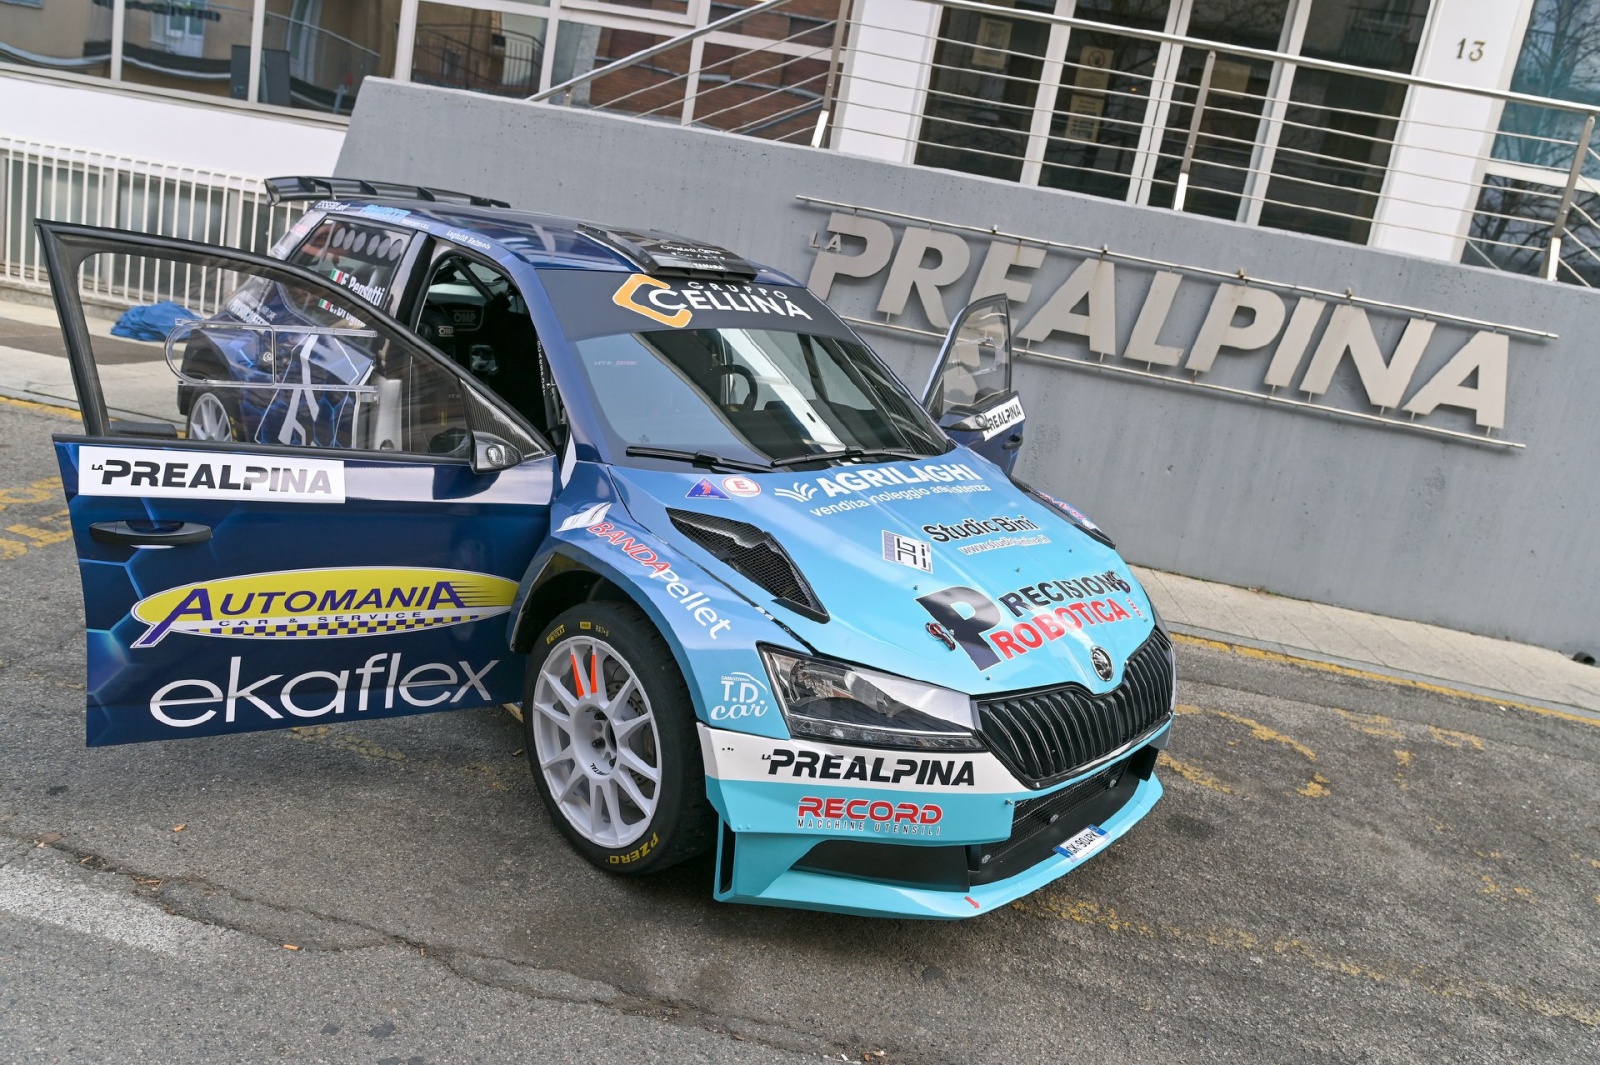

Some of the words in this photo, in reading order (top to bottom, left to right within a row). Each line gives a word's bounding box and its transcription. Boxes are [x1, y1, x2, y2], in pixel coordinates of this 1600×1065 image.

[1456, 38, 1486, 62] 13
[808, 230, 842, 252] LA
[348, 275, 386, 307] Pensotti
[648, 287, 814, 321] CELLINA
[687, 281, 788, 300] GRUPPO
[438, 327, 454, 335] OMP
[453, 312, 477, 324] OMP
[806, 211, 1509, 429] PREALPINA
[986, 403, 1022, 434] REALPINA
[91, 463, 104, 471] LA
[101, 459, 332, 494] PREALPINA
[816, 463, 983, 498] AGRILAGHI
[809, 498, 870, 517] vendita
[870, 487, 930, 504] noleggio
[930, 483, 992, 495] assistenza
[922, 519, 1000, 543] Studio
[991, 515, 1042, 533] Bini
[586, 521, 671, 576] BANDA
[649, 568, 732, 640] Pellet
[139, 581, 468, 645] AUTOMANIA
[318, 611, 422, 622] SERVICE
[989, 598, 1131, 661] ROBOTICA
[149, 653, 500, 728] ekaflex
[761, 753, 771, 761] LA
[768, 748, 975, 786] PREALPINA
[797, 796, 943, 825] RECORD
[797, 818, 866, 832] MACCHINE
[874, 822, 942, 837] UTENSILI
